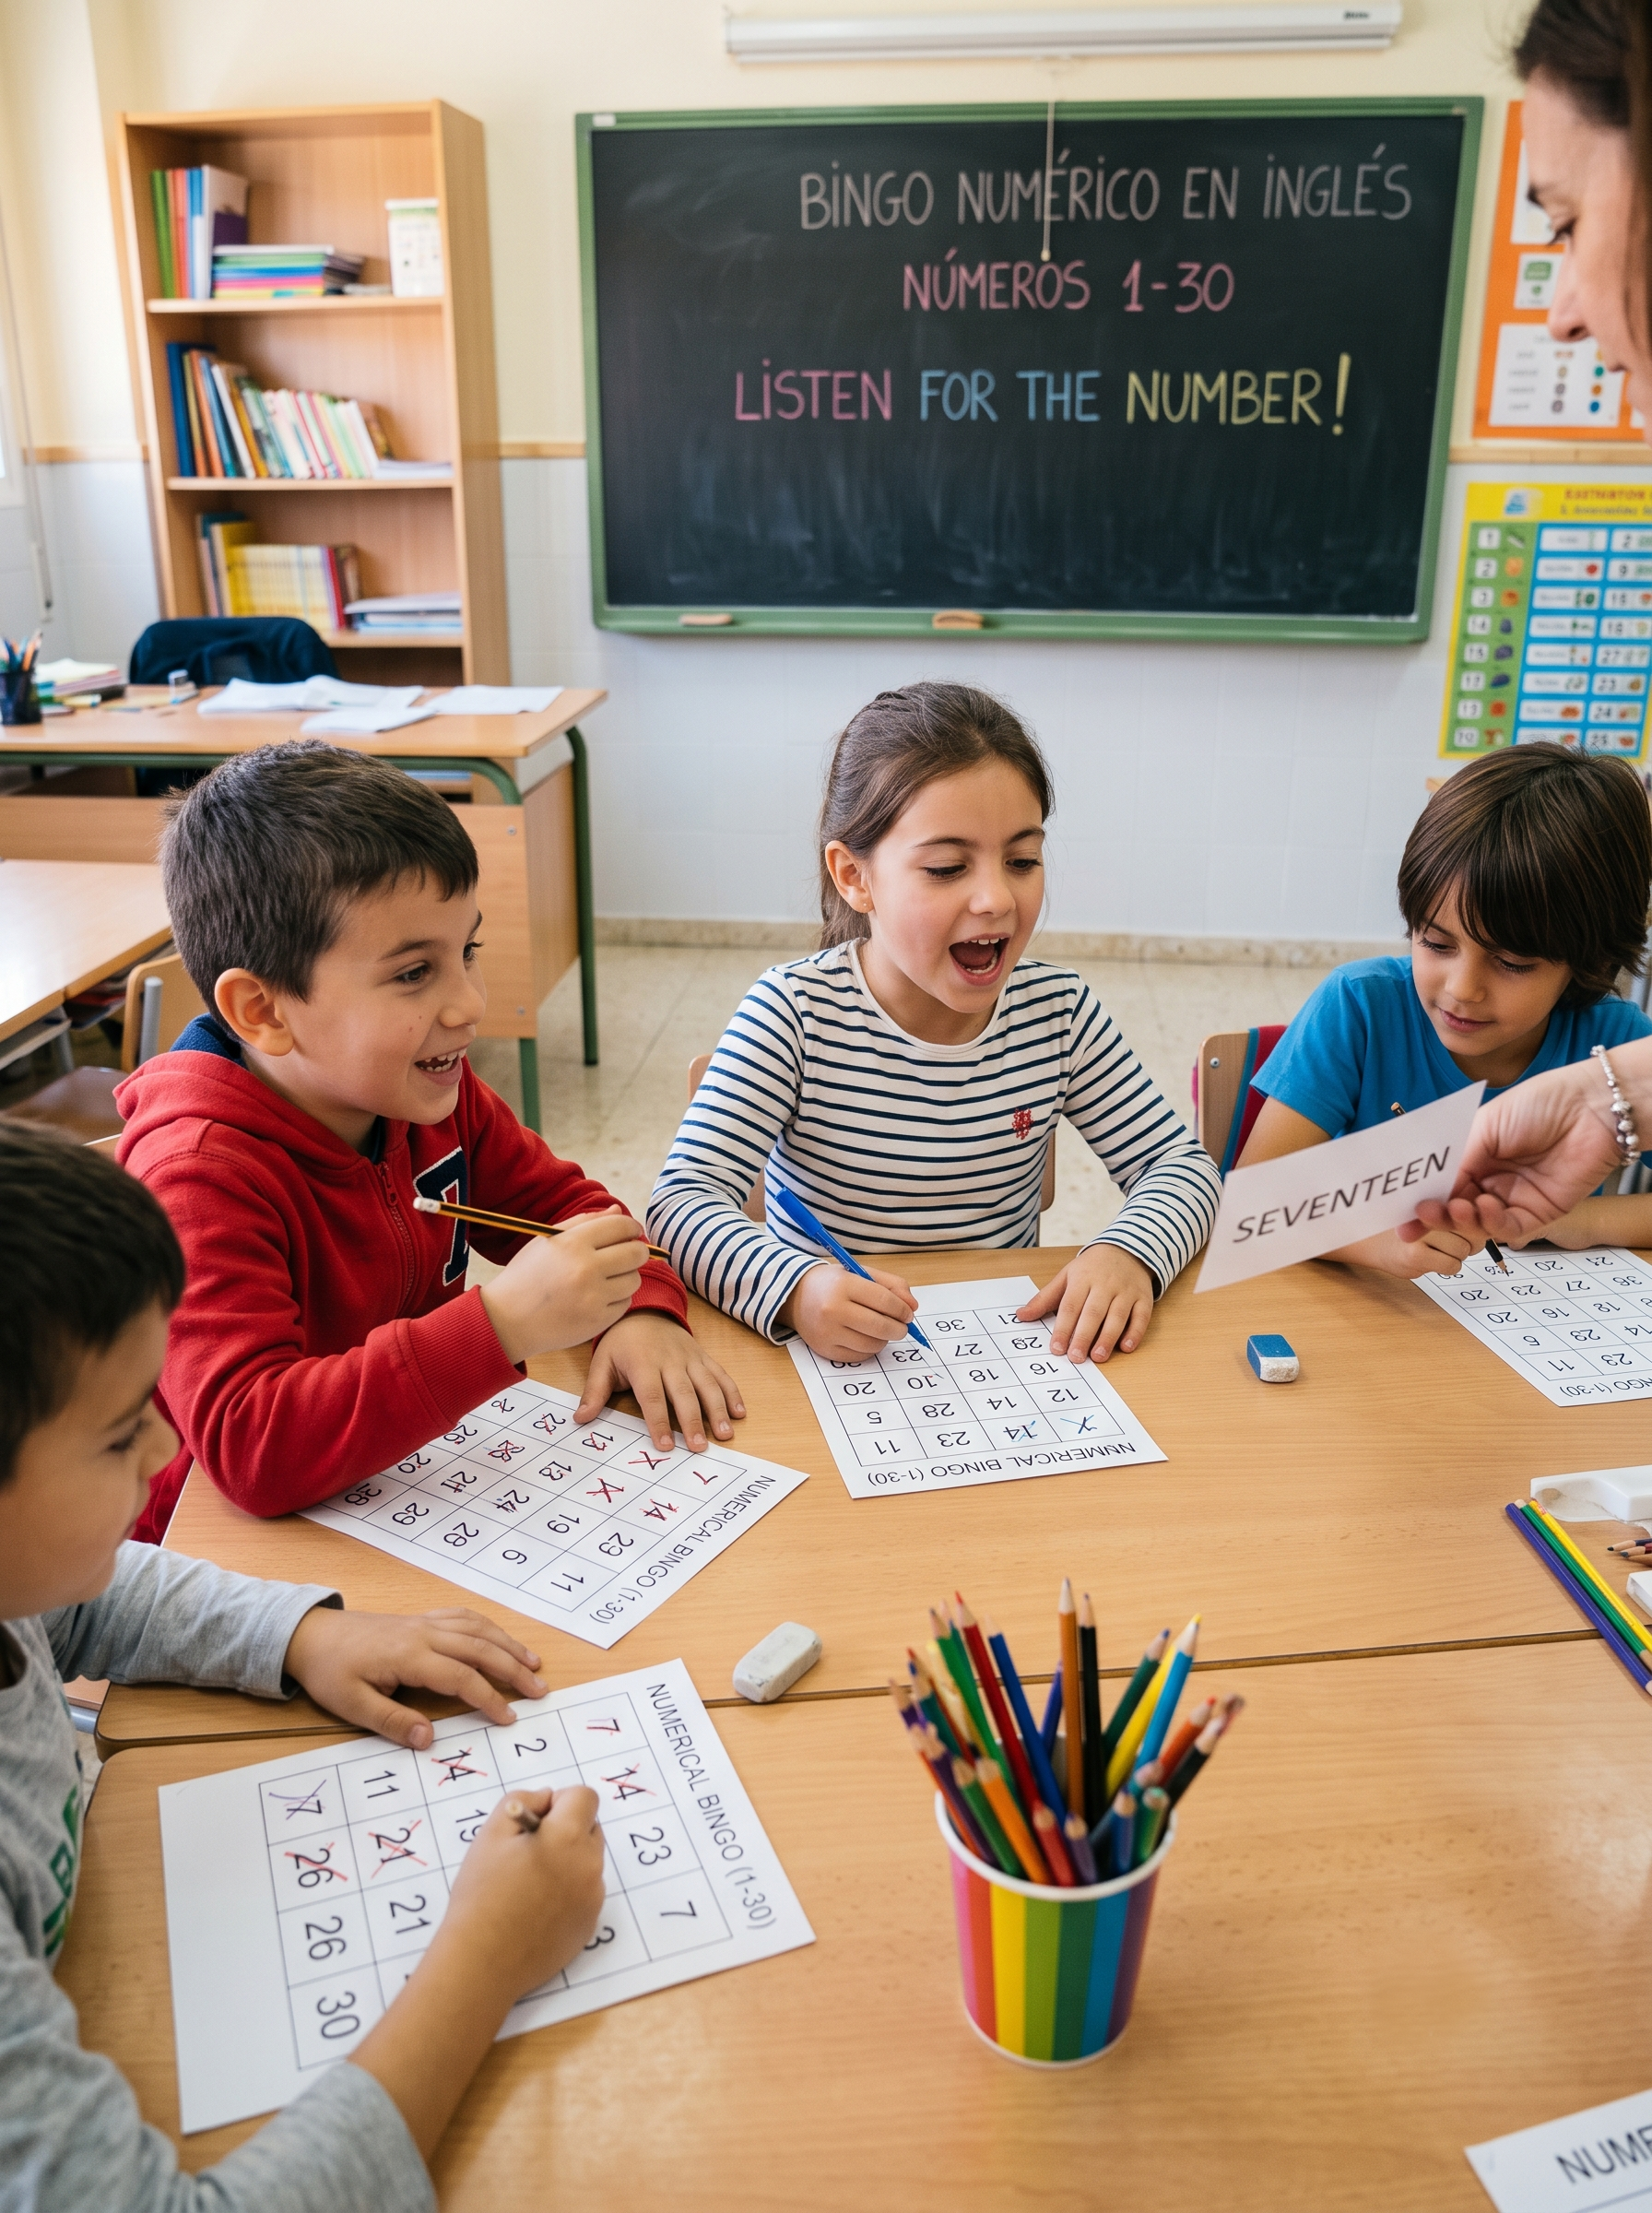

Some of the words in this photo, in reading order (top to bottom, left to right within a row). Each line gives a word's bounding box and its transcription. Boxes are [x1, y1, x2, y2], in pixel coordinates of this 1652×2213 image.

[957, 148, 1161, 226] NUMÉRICO
[1183, 166, 1238, 221] EN
[1264, 143, 1413, 221] INGLÉS
[903, 247, 1092, 312] NÚMEROS
[1121, 260, 1235, 314] 1-30
[735, 359, 892, 422] LISTEN
[920, 369, 997, 422] FOR
[1016, 369, 1102, 422] THE
[1126, 352, 1351, 436] NUMBER!
[1232, 1145, 1451, 1244] SEVENTEEN
[1534, 1260, 1564, 1272] 20
[1460, 1289, 1490, 1301] 20
[1511, 1284, 1540, 1296] 23
[1566, 1280, 1591, 1292] 27
[1487, 1311, 1518, 1323] 20
[1541, 1307, 1570, 1319] 16
[935, 1319, 965, 1332] 36
[892, 1348, 923, 1362] 23
[954, 1343, 984, 1357] 27
[1029, 1361, 1059, 1376] 16
[1548, 1359, 1575, 1372] 11
[907, 1375, 938, 1391] 10
[968, 1368, 999, 1383] 18
[843, 1381, 876, 1396] 20
[1047, 1388, 1080, 1403] 12
[1559, 1381, 1612, 1398] (1-30)
[922, 1402, 955, 1418] 28
[986, 1395, 1018, 1411] 14
[866, 1411, 883, 1425] 5
[874, 1439, 902, 1456] 11
[937, 1430, 971, 1448] 23
[867, 1467, 926, 1486] (1-30)
[930, 1459, 1001, 1478] BINGO
[692, 1471, 719, 1485] 7
[392, 1502, 430, 1525] 29
[685, 1474, 776, 1544] NUMERICAL
[547, 1514, 580, 1533] 19
[502, 1549, 527, 1566] 6
[636, 1542, 693, 1588] BINGO
[549, 1572, 584, 1593] 11
[588, 1587, 643, 1626] (1-30)
[513, 1737, 548, 1757] 2
[438, 1749, 478, 1783] 14
[363, 1770, 400, 1799] 11
[647, 1684, 712, 1793] NUMERICAL
[696, 1794, 743, 1862] BINGO
[725, 1864, 777, 1931] (1-30)
[376, 1827, 415, 1865] 21
[604, 1768, 646, 1801] 14
[629, 1827, 673, 1867] 23
[659, 1900, 698, 1923] 7
[294, 1847, 335, 1889] 26
[388, 1894, 431, 1935] 21
[304, 1915, 347, 1961] 26
[316, 1991, 361, 2041] 30
